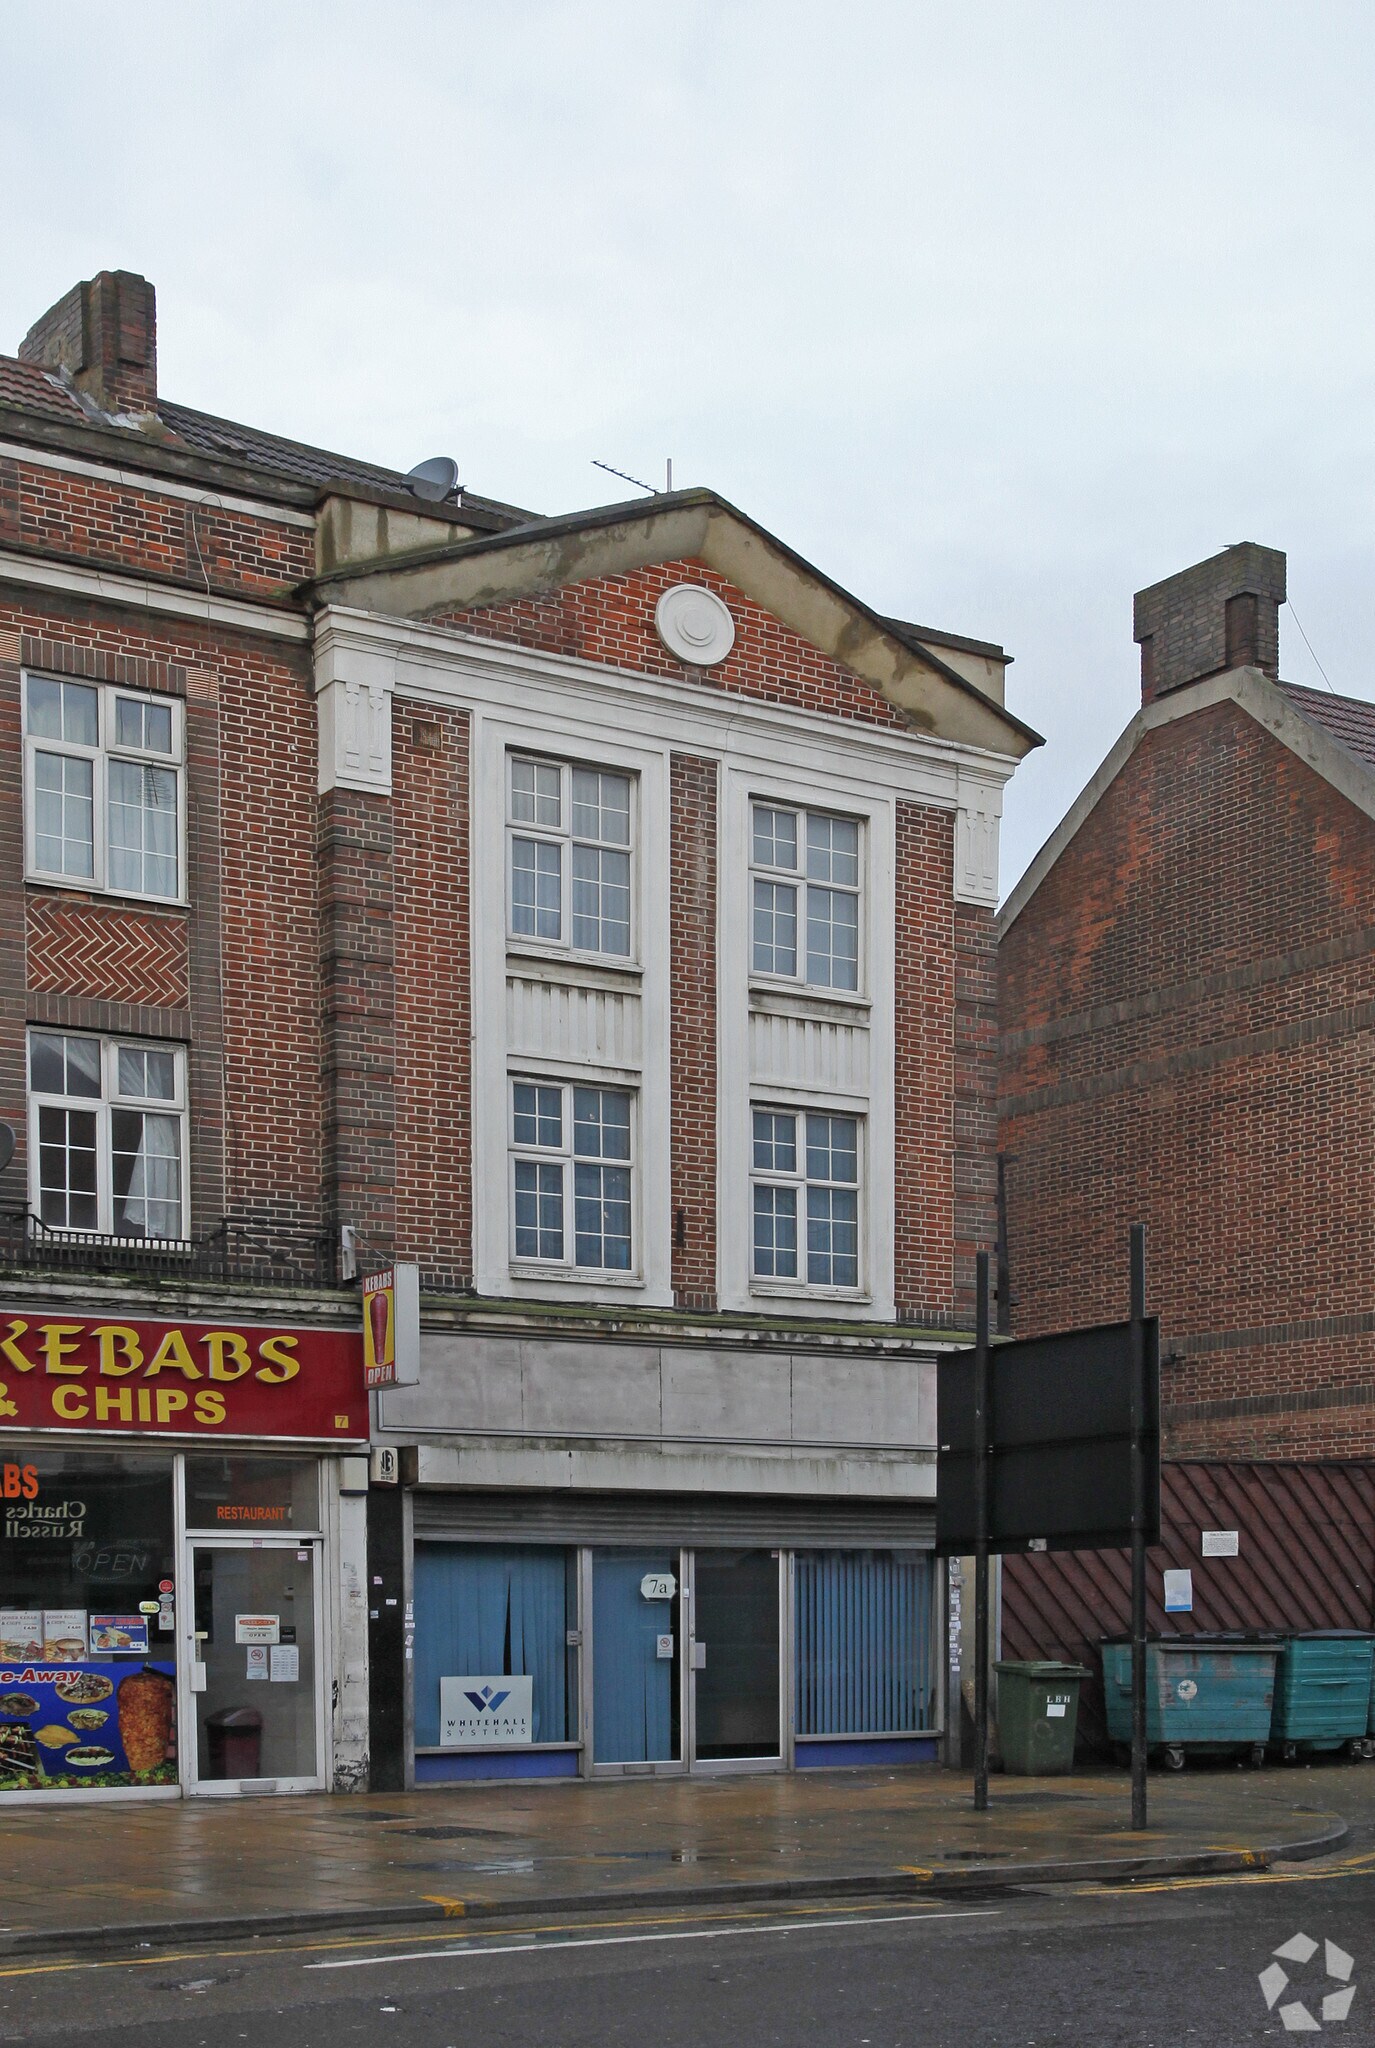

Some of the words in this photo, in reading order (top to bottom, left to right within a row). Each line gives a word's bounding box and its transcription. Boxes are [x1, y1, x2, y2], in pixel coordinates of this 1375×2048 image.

[365, 1271, 392, 1294] KEBABS
[0, 1319, 300, 1384] KEBABS
[368, 1365, 392, 1384] OPEN
[52, 1384, 226, 1425] CHIPS
[337, 1416, 346, 1428] 7
[0, 1463, 39, 1499] BS
[217, 1506, 286, 1520] RESTAURANT
[76, 1553, 147, 1572] OPEN
[649, 1579, 668, 1594] 7a
[446, 1727, 526, 1737] SYSTEMS
[447, 1718, 526, 1727] WHITEHALL
